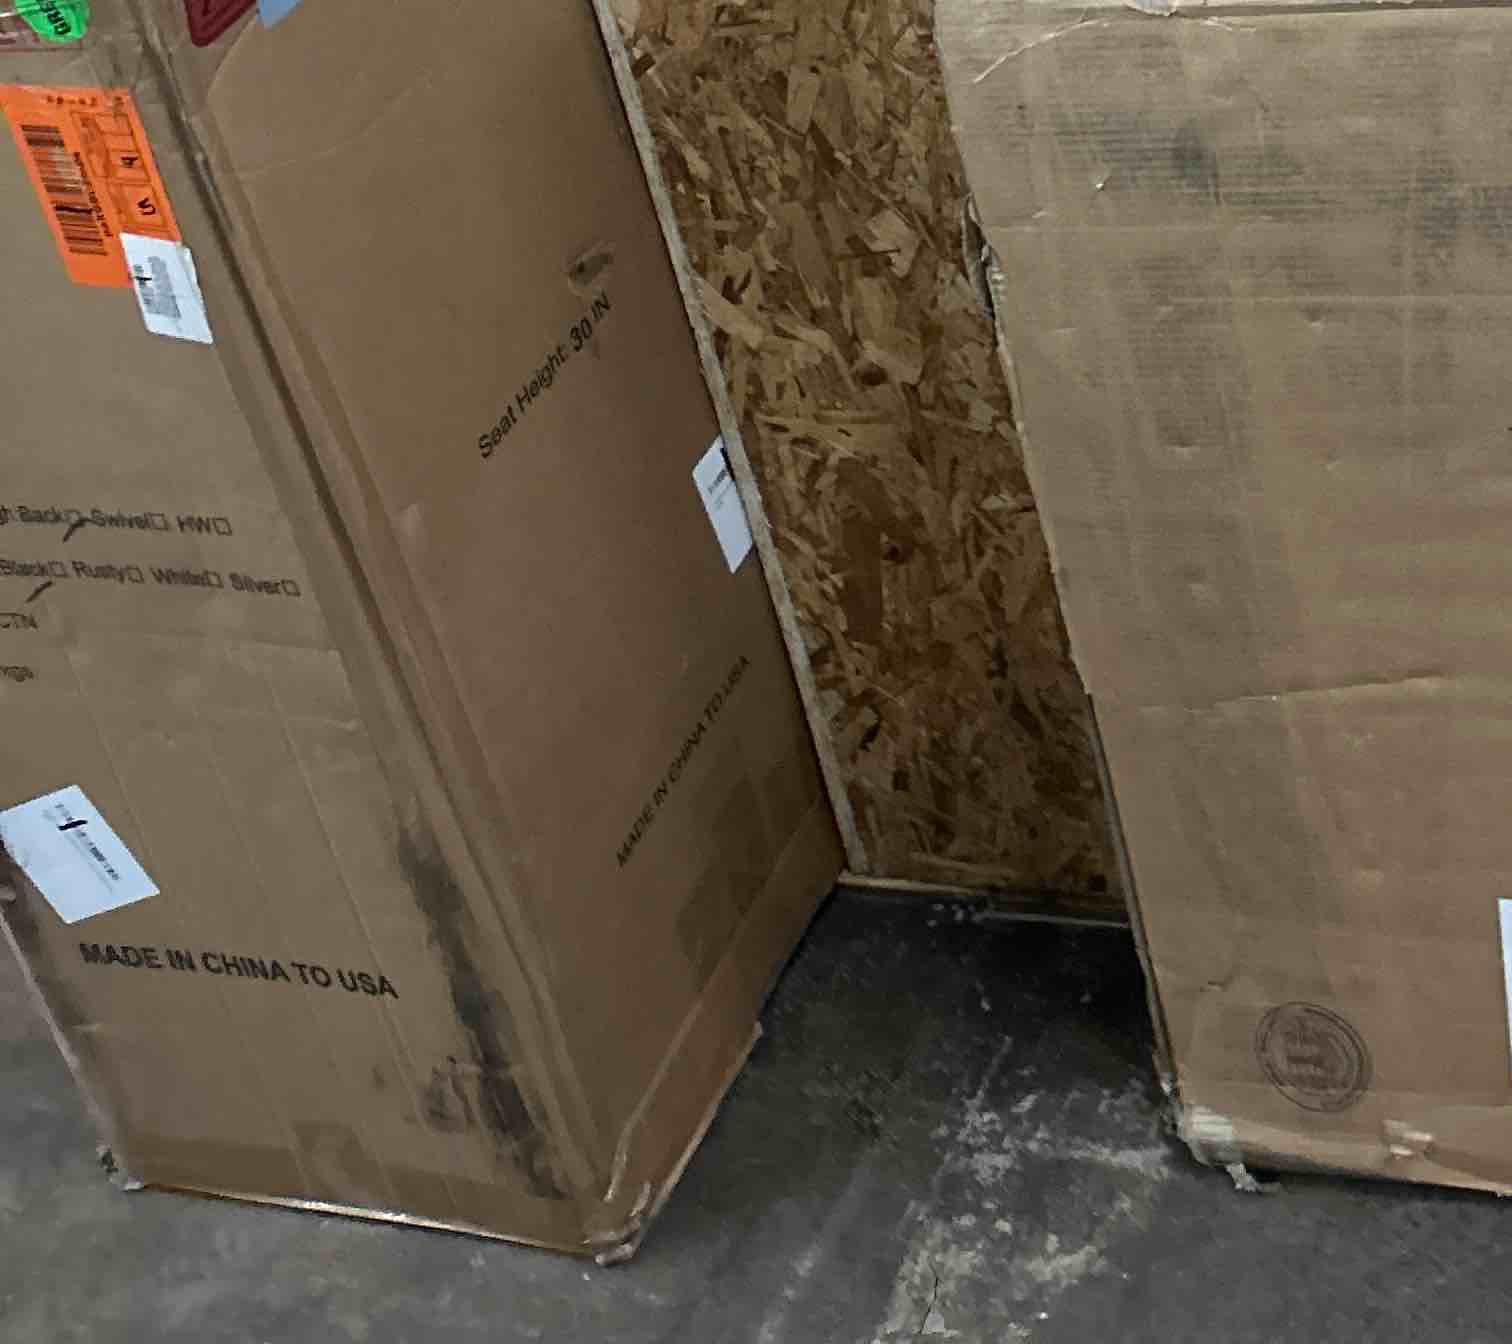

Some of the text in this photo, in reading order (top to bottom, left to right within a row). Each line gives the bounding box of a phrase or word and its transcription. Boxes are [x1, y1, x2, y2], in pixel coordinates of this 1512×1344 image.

[478, 404, 518, 459] Seat
[570, 316, 593, 353] 30
[591, 291, 611, 321] IN
[79, 941, 400, 1000] MADE IN CHINA TO USA
